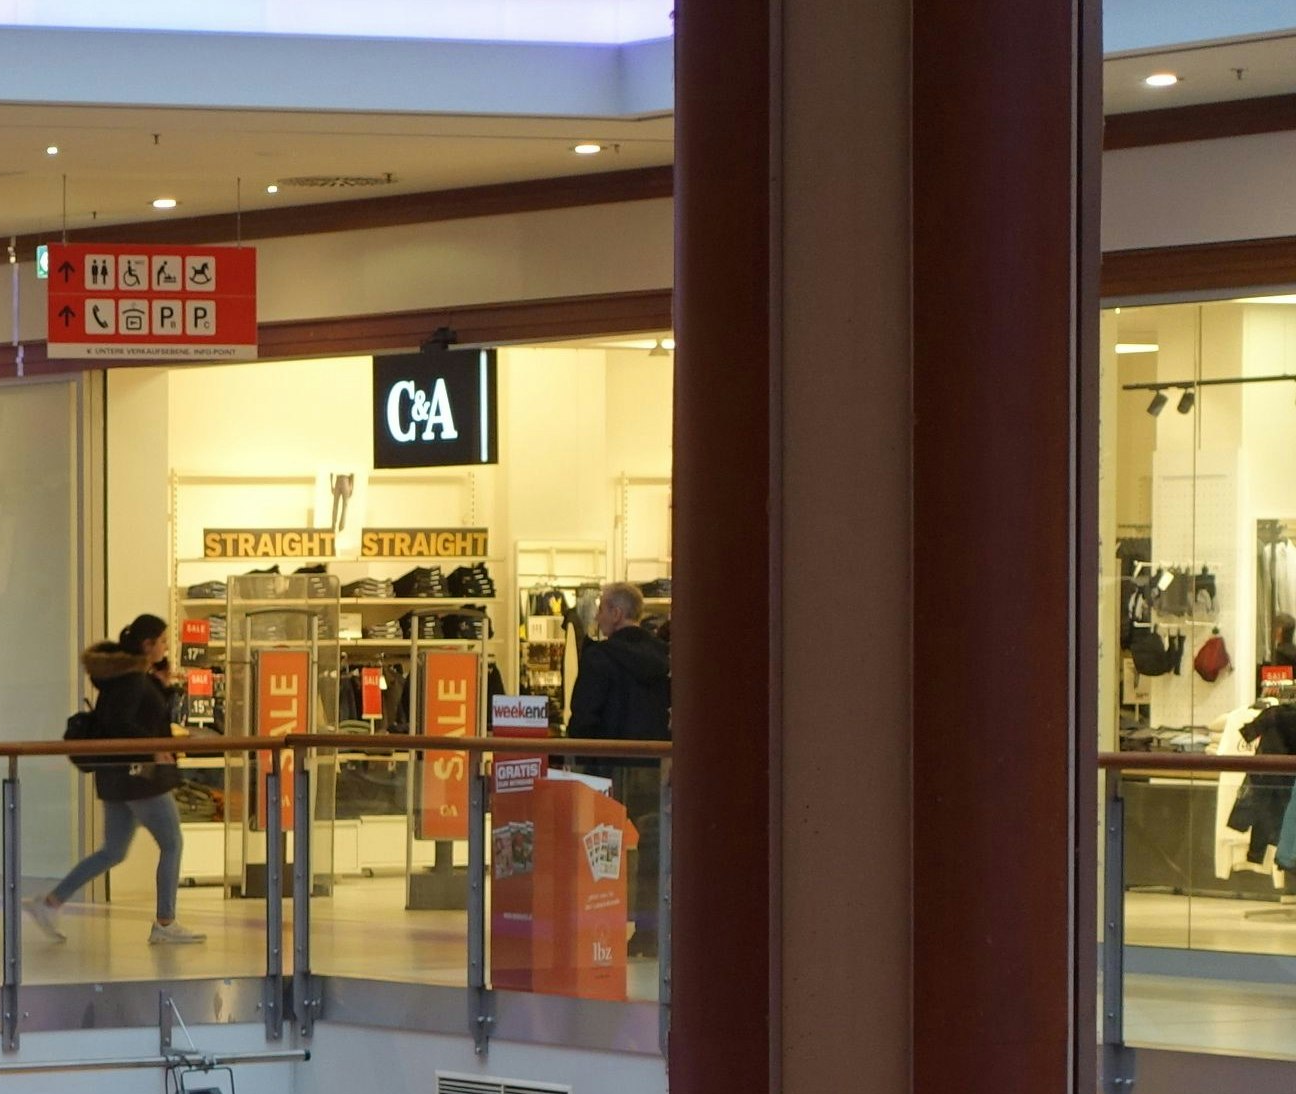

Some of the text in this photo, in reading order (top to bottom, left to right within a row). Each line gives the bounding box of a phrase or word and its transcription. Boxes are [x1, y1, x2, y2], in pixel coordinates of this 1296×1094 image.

[387, 377, 458, 442] C&A
[205, 532, 335, 557] STRAIGHT
[362, 532, 488, 557] STRAIGHT
[187, 624, 206, 633] SALE
[494, 701, 548, 719] weekend
[498, 763, 539, 780] GRATIS
